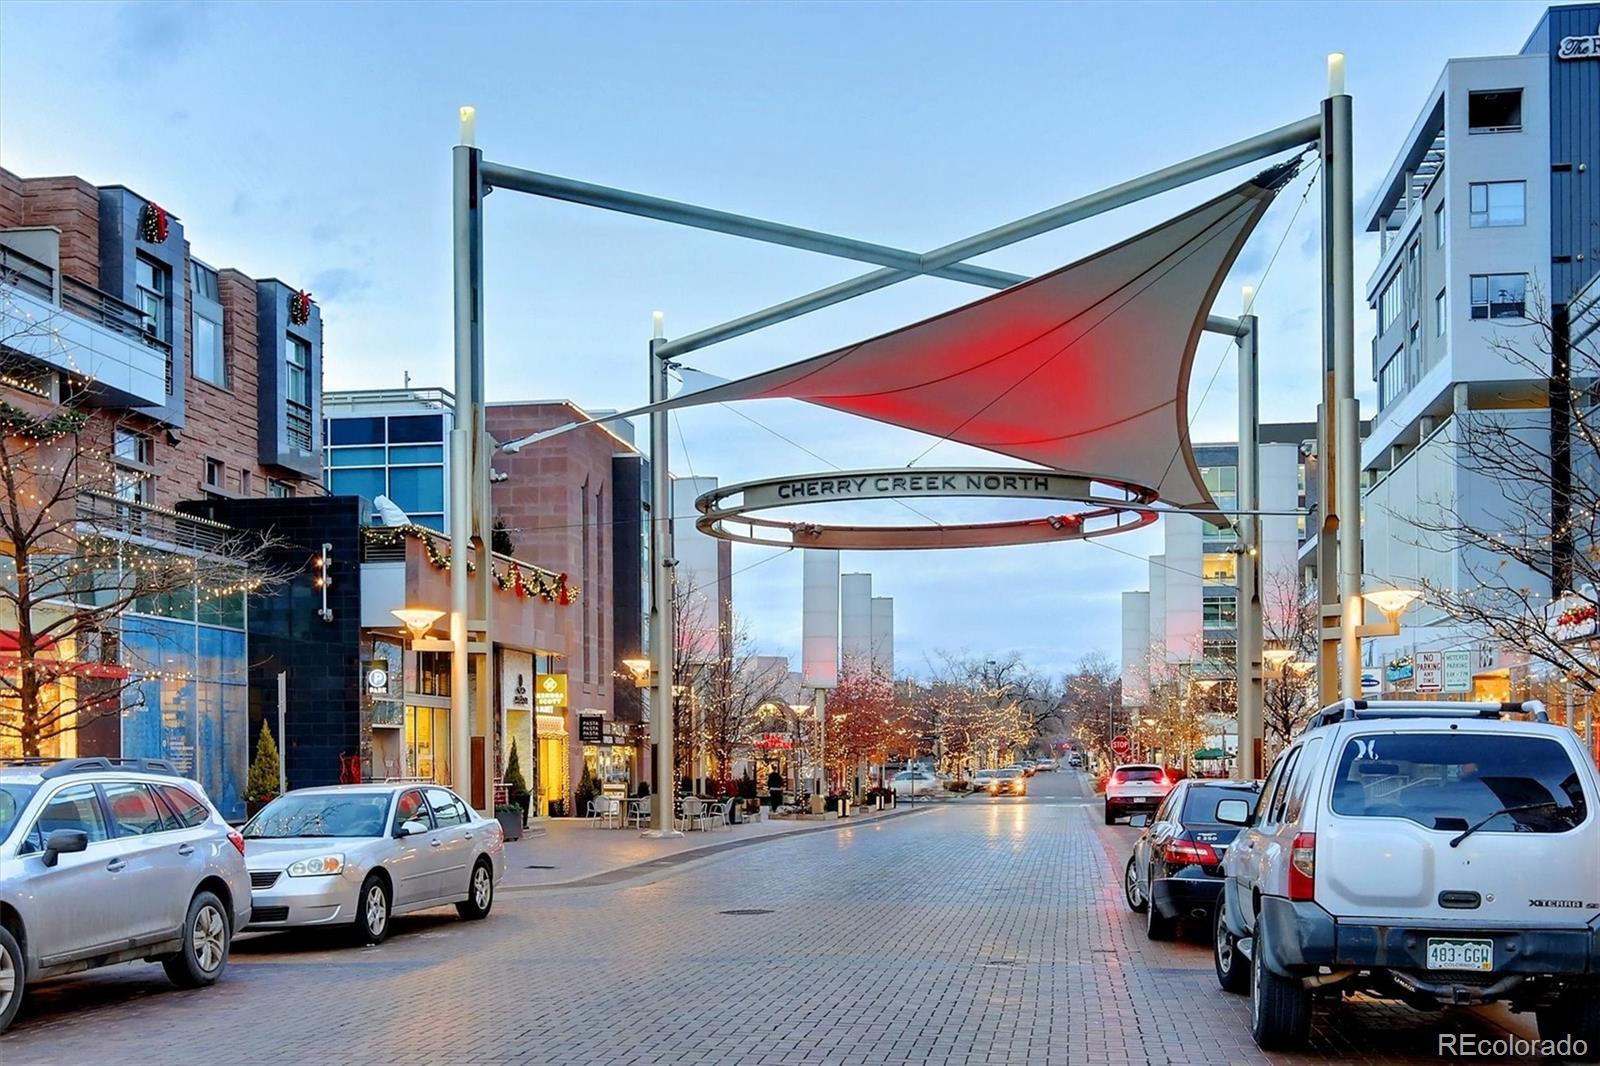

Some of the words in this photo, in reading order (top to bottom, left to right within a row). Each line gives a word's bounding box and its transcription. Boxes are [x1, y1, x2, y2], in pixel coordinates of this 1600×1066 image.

[1562, 38, 1589, 55] The
[778, 478, 867, 498] CHERRY
[874, 476, 956, 491] CREEK
[966, 475, 1049, 490] NORTH
[1529, 899, 1583, 908] XTERRA
